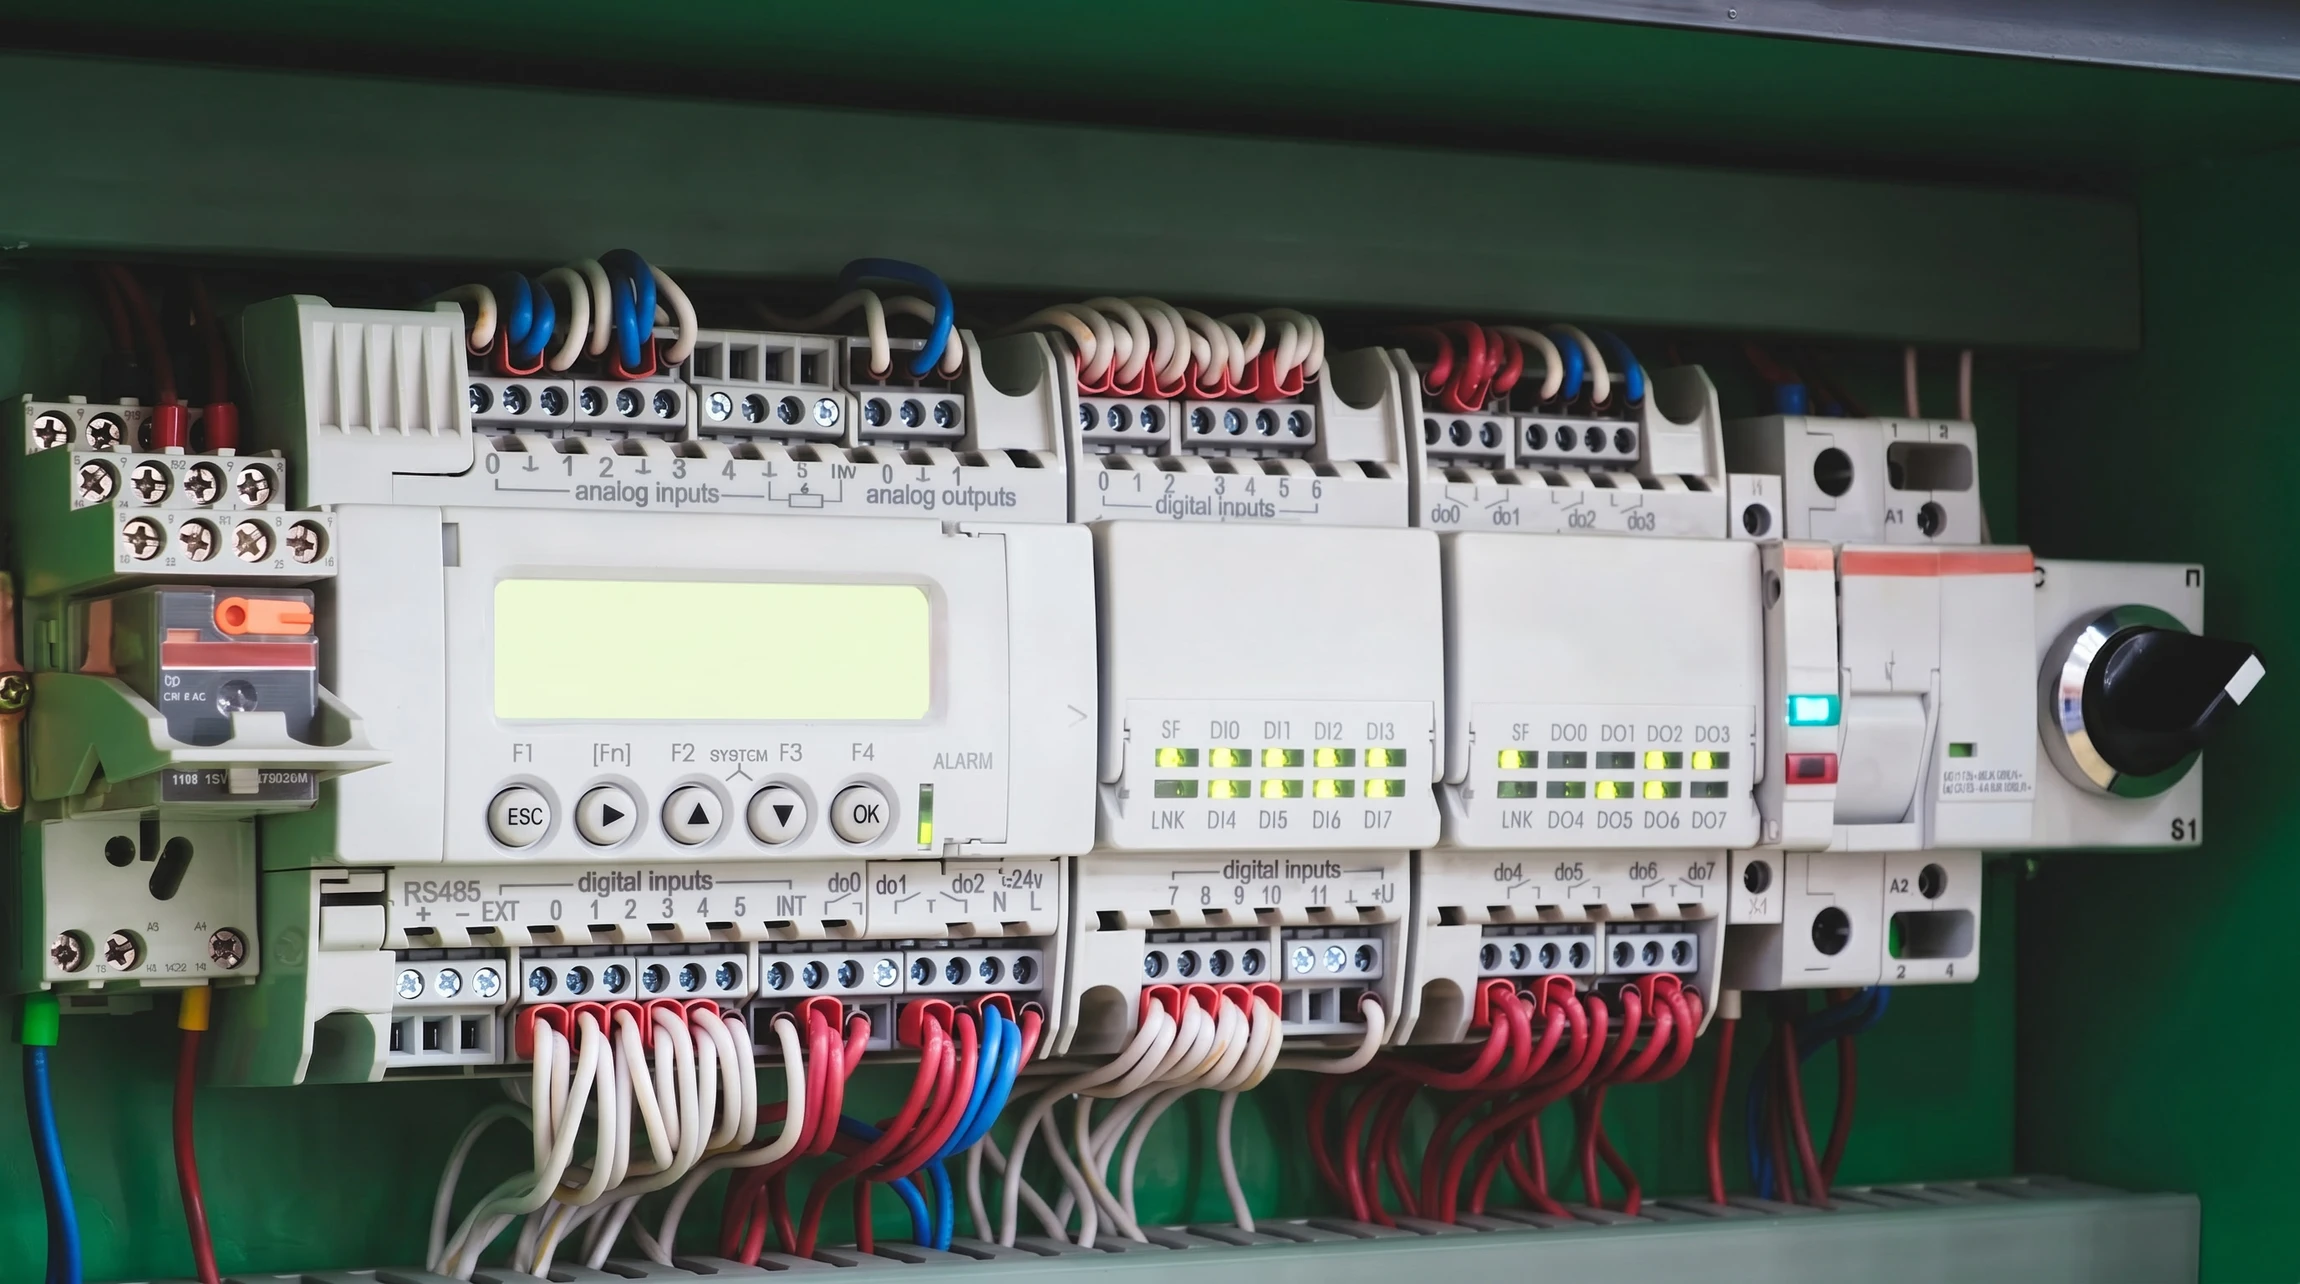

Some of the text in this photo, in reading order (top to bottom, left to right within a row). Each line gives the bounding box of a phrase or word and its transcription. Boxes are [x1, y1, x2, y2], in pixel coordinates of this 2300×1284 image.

[485, 453, 501, 475] 0
[562, 455, 574, 477] 1
[599, 456, 614, 478] 2
[672, 458, 686, 480] 3
[721, 459, 737, 481] 4
[882, 464, 894, 485] 0
[952, 466, 961, 487] 1
[575, 479, 720, 508] analog inputs
[1099, 470, 1322, 500] 0 1 2 3 4 5 6
[866, 484, 1017, 512] analog outputs
[1156, 494, 1276, 521] digital inputs
[1431, 503, 1656, 531] do0 do1 do2 do3
[1885, 509, 1903, 524] A1
[1161, 719, 1395, 741] SF DI0 DI1 DI2 DI3
[1512, 723, 1731, 744] SF DO0 DO1 DO2 DO3
[513, 743, 533, 763] F1
[593, 742, 632, 768] [Fn]
[672, 743, 696, 763] F2
[780, 743, 803, 762] F3
[852, 743, 875, 762] F4
[933, 752, 993, 770] ALARM
[172, 774, 198, 785] 1108
[508, 804, 880, 826] ESC OK
[1151, 810, 1393, 829] LNK DI4 DI5 DI6 DI7
[1502, 810, 1727, 829] LNK DO4 DO5 DO6 DO7
[2171, 816, 2196, 842] S1
[1223, 859, 1342, 884] digital inputs
[1494, 862, 1715, 882] do4 do5 do6 do7
[404, 880, 482, 906] RS485
[578, 869, 713, 897] digital inputs
[828, 872, 862, 893] do0
[875, 875, 907, 895] do1
[952, 873, 986, 894] do2
[1890, 878, 1910, 894] A2
[993, 890, 1043, 912] N L
[1168, 886, 1179, 906] 7
[1200, 885, 1211, 905] 8
[1234, 885, 1245, 905] 9
[1262, 884, 1282, 905] 10
[1311, 884, 1328, 905] 11
[482, 900, 520, 922] EXT
[550, 900, 563, 921] 0
[590, 899, 599, 920] 1
[624, 899, 638, 919] 2
[661, 898, 675, 919] 3
[697, 898, 710, 918] 4
[734, 896, 747, 917] 5
[776, 896, 807, 917] INT
[1896, 965, 1906, 979] 2
